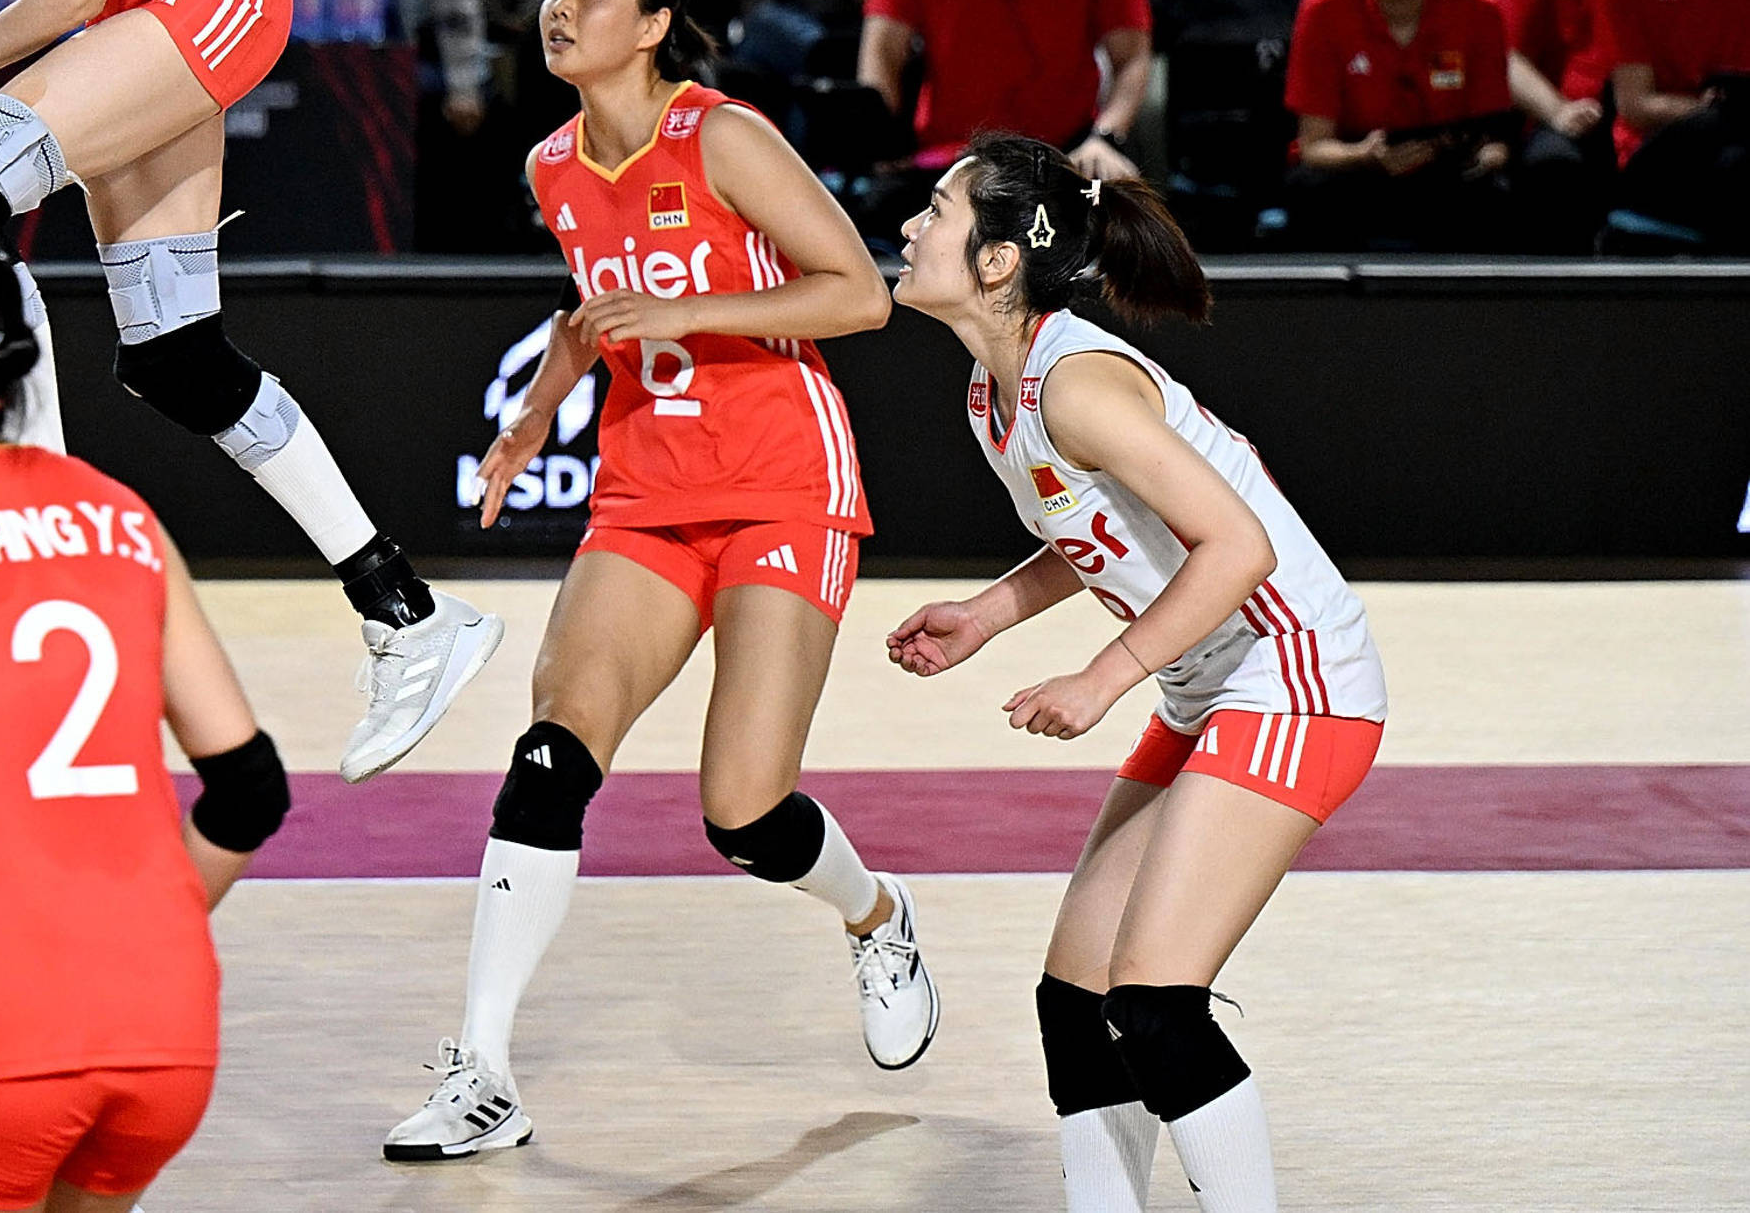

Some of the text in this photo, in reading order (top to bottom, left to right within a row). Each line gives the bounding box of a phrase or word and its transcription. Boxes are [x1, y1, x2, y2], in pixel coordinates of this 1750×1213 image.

[653, 214, 683, 227] CHN
[1044, 494, 1071, 512] CHN
[10, 598, 139, 800] 2
